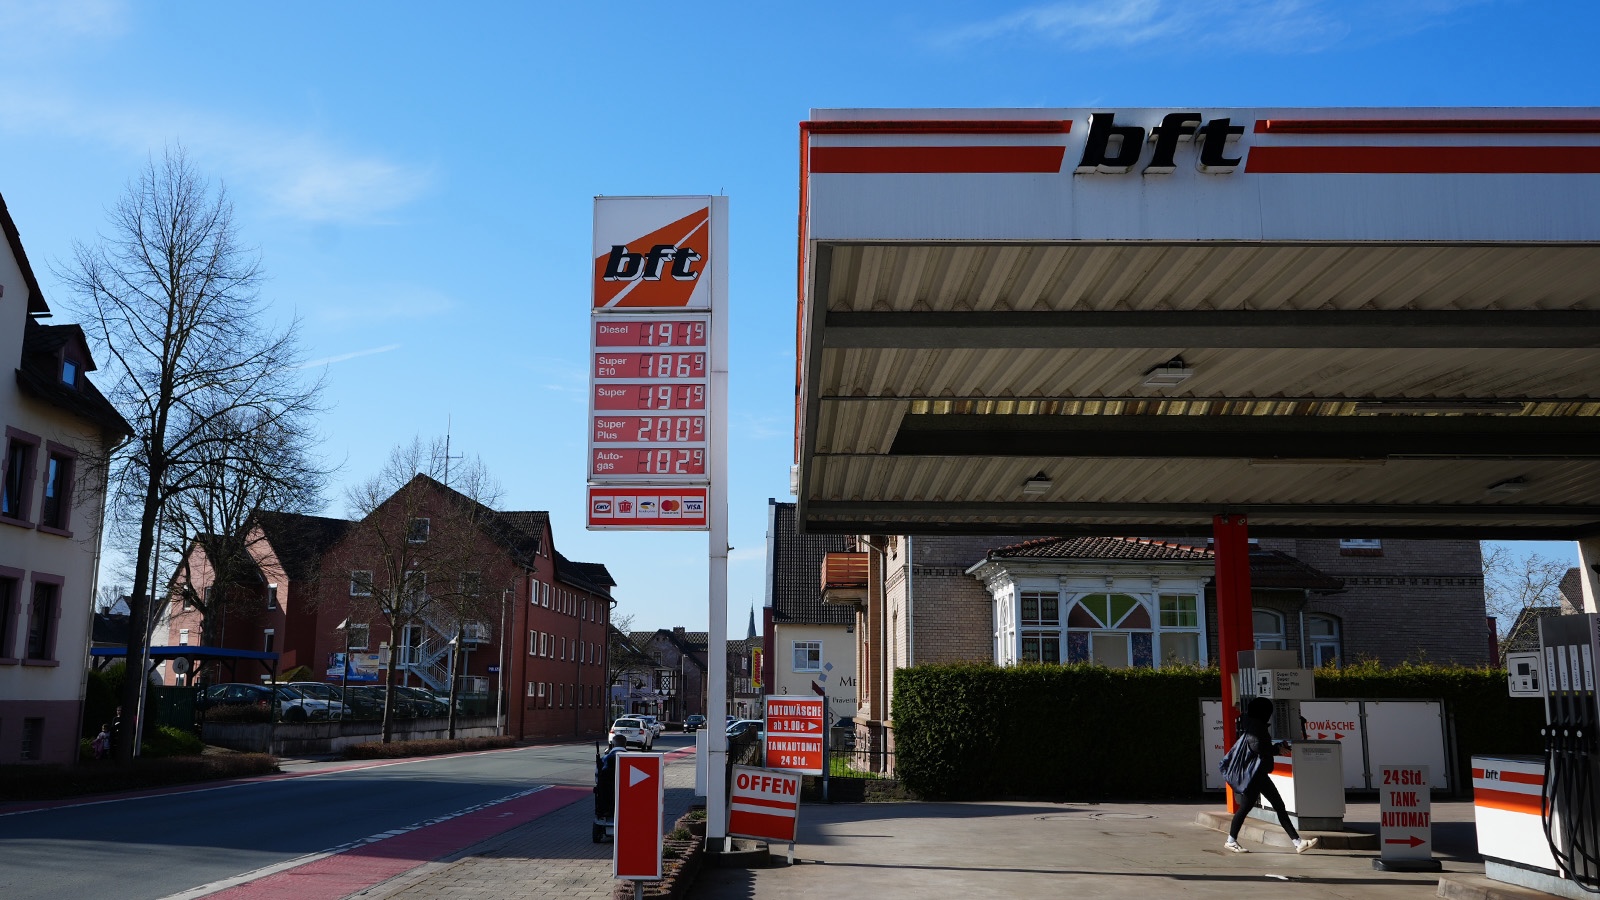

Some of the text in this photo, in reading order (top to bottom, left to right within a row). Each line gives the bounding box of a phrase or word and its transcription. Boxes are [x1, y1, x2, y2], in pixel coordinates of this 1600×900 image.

[1074, 112, 1245, 173] bft
[602, 244, 702, 281] bft
[599, 325, 628, 334] Diesel
[598, 356, 628, 366] Super
[598, 367, 616, 376] E10
[598, 388, 626, 398] Super
[597, 420, 626, 430] Super
[597, 431, 618, 440] Plus
[596, 451, 624, 460] Auto-
[596, 462, 614, 472] gas
[781, 686, 788, 695] 3
[768, 704, 822, 717] AUTOWÄSCHE
[773, 720, 782, 731] ab
[768, 742, 820, 752] TANKAUTOMAT
[780, 755, 808, 766] 24 Std.
[1383, 769, 1426, 786] 24 Std.
[1485, 768, 1499, 780] bft
[736, 773, 796, 795] OFFEN
[1390, 791, 1420, 808] TANK-
[1382, 812, 1430, 827] AUTOMAT
